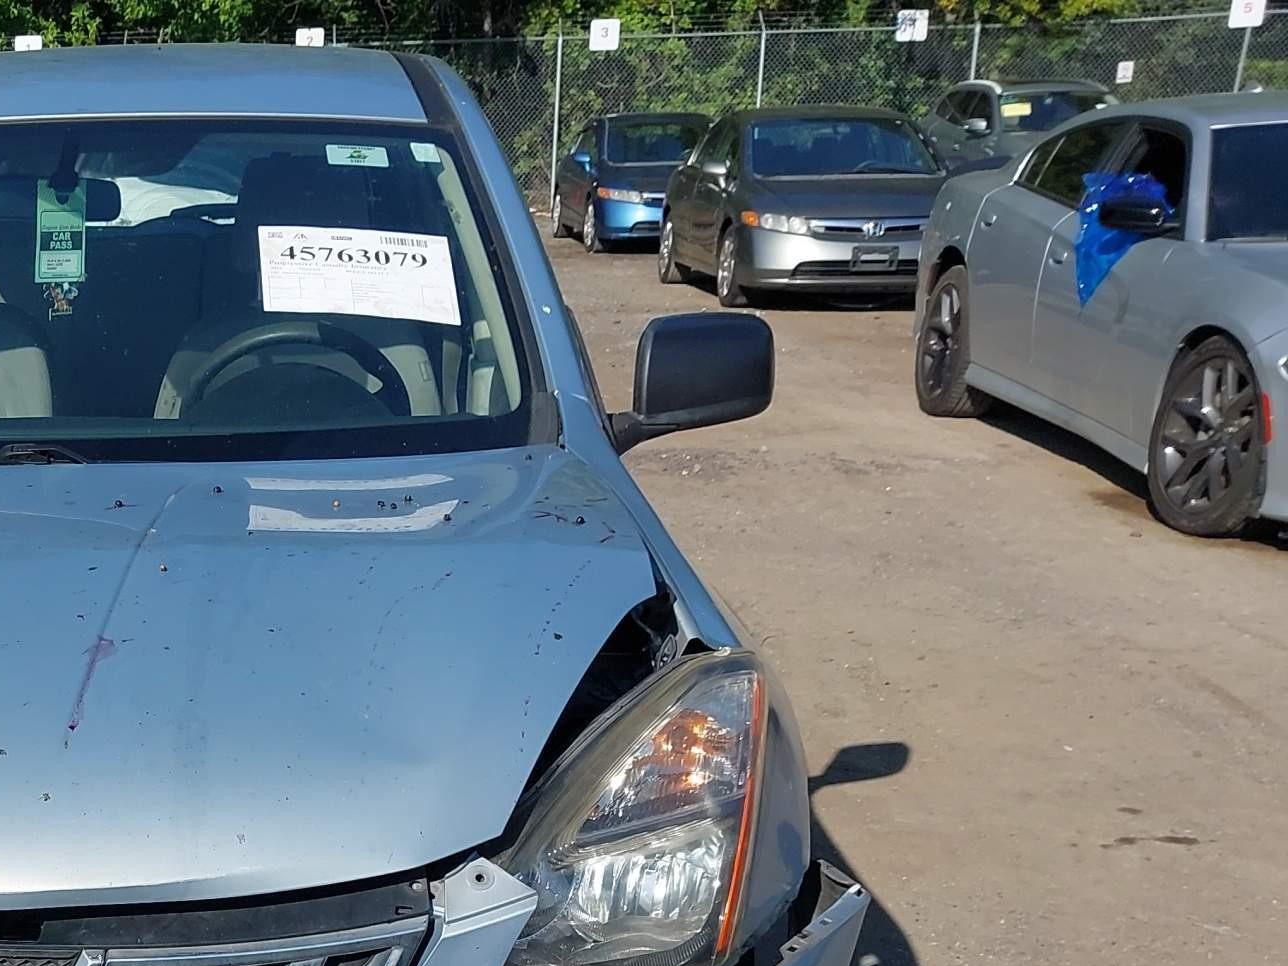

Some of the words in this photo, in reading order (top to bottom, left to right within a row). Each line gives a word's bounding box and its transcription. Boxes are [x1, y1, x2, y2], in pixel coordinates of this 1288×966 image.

[601, 27, 609, 38] 3
[52, 232, 72, 241] CAR
[49, 241, 72, 250] PASS
[280, 246, 427, 268] 45763079
